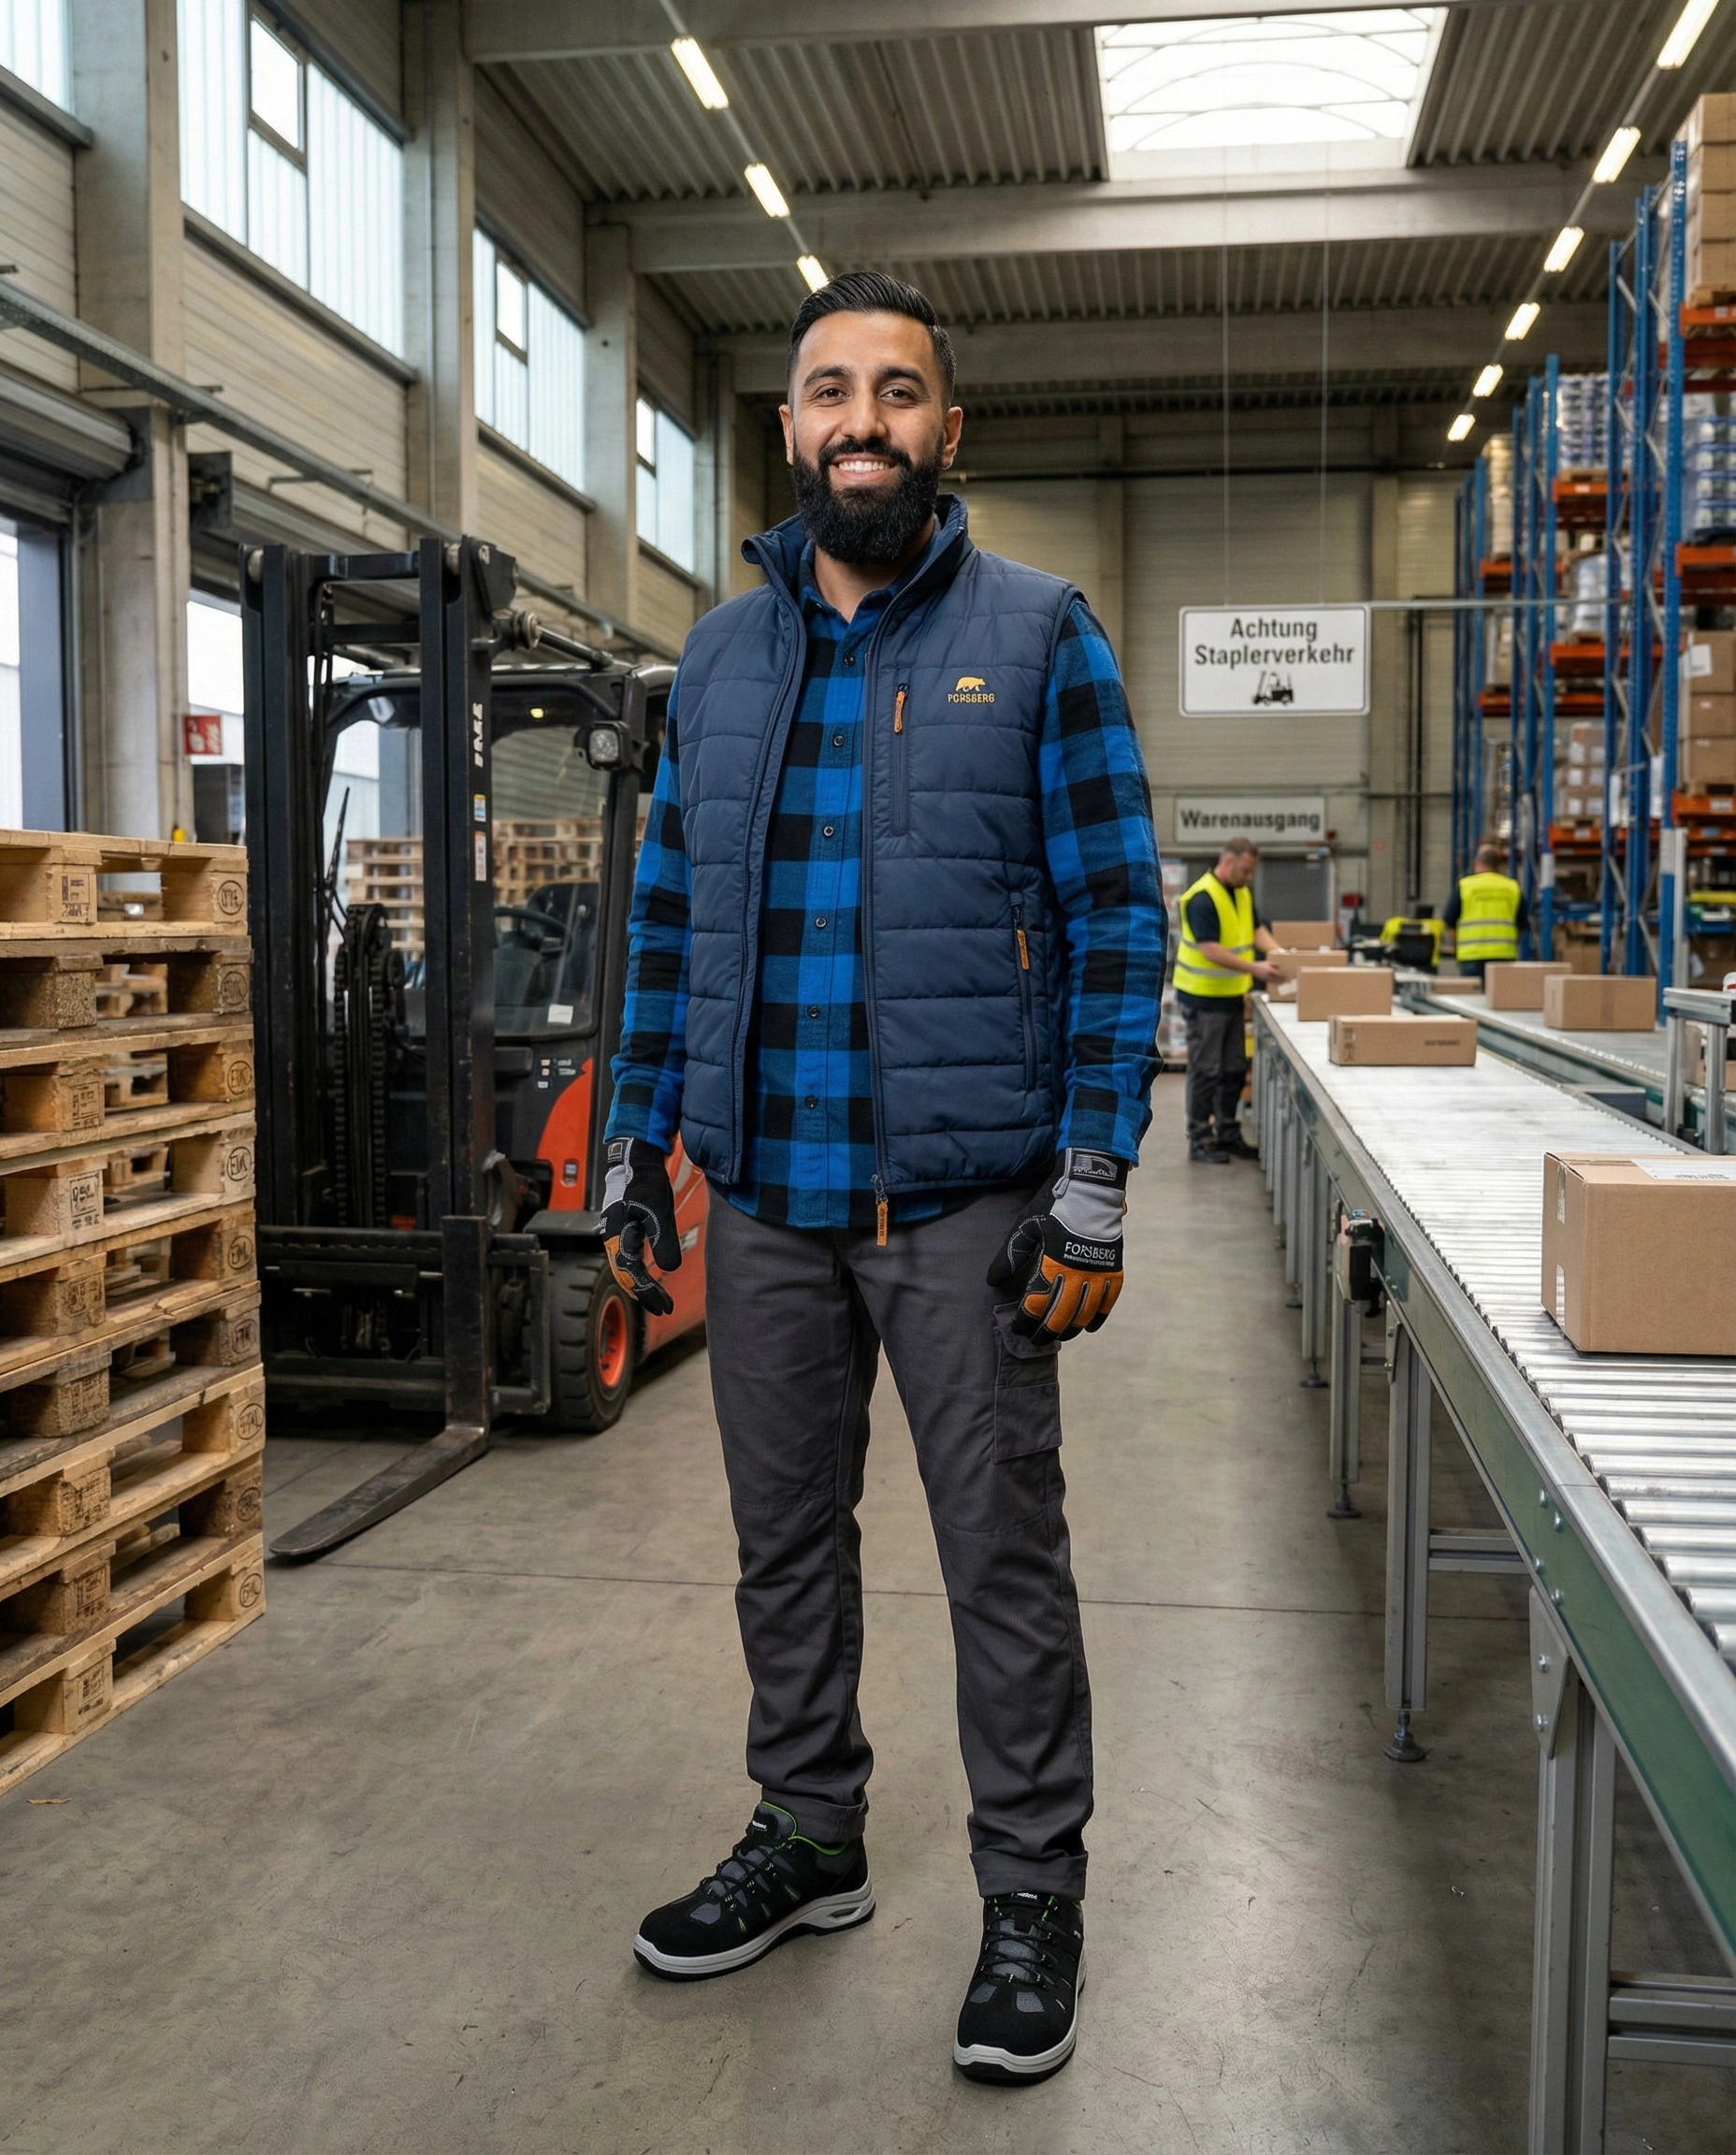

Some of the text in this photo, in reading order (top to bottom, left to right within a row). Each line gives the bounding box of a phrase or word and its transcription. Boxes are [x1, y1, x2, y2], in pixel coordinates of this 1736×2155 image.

[1230, 618, 1317, 642] Achtung
[1194, 643, 1354, 670] Staplerverkehr
[1180, 809, 1321, 832] Warenausgang
